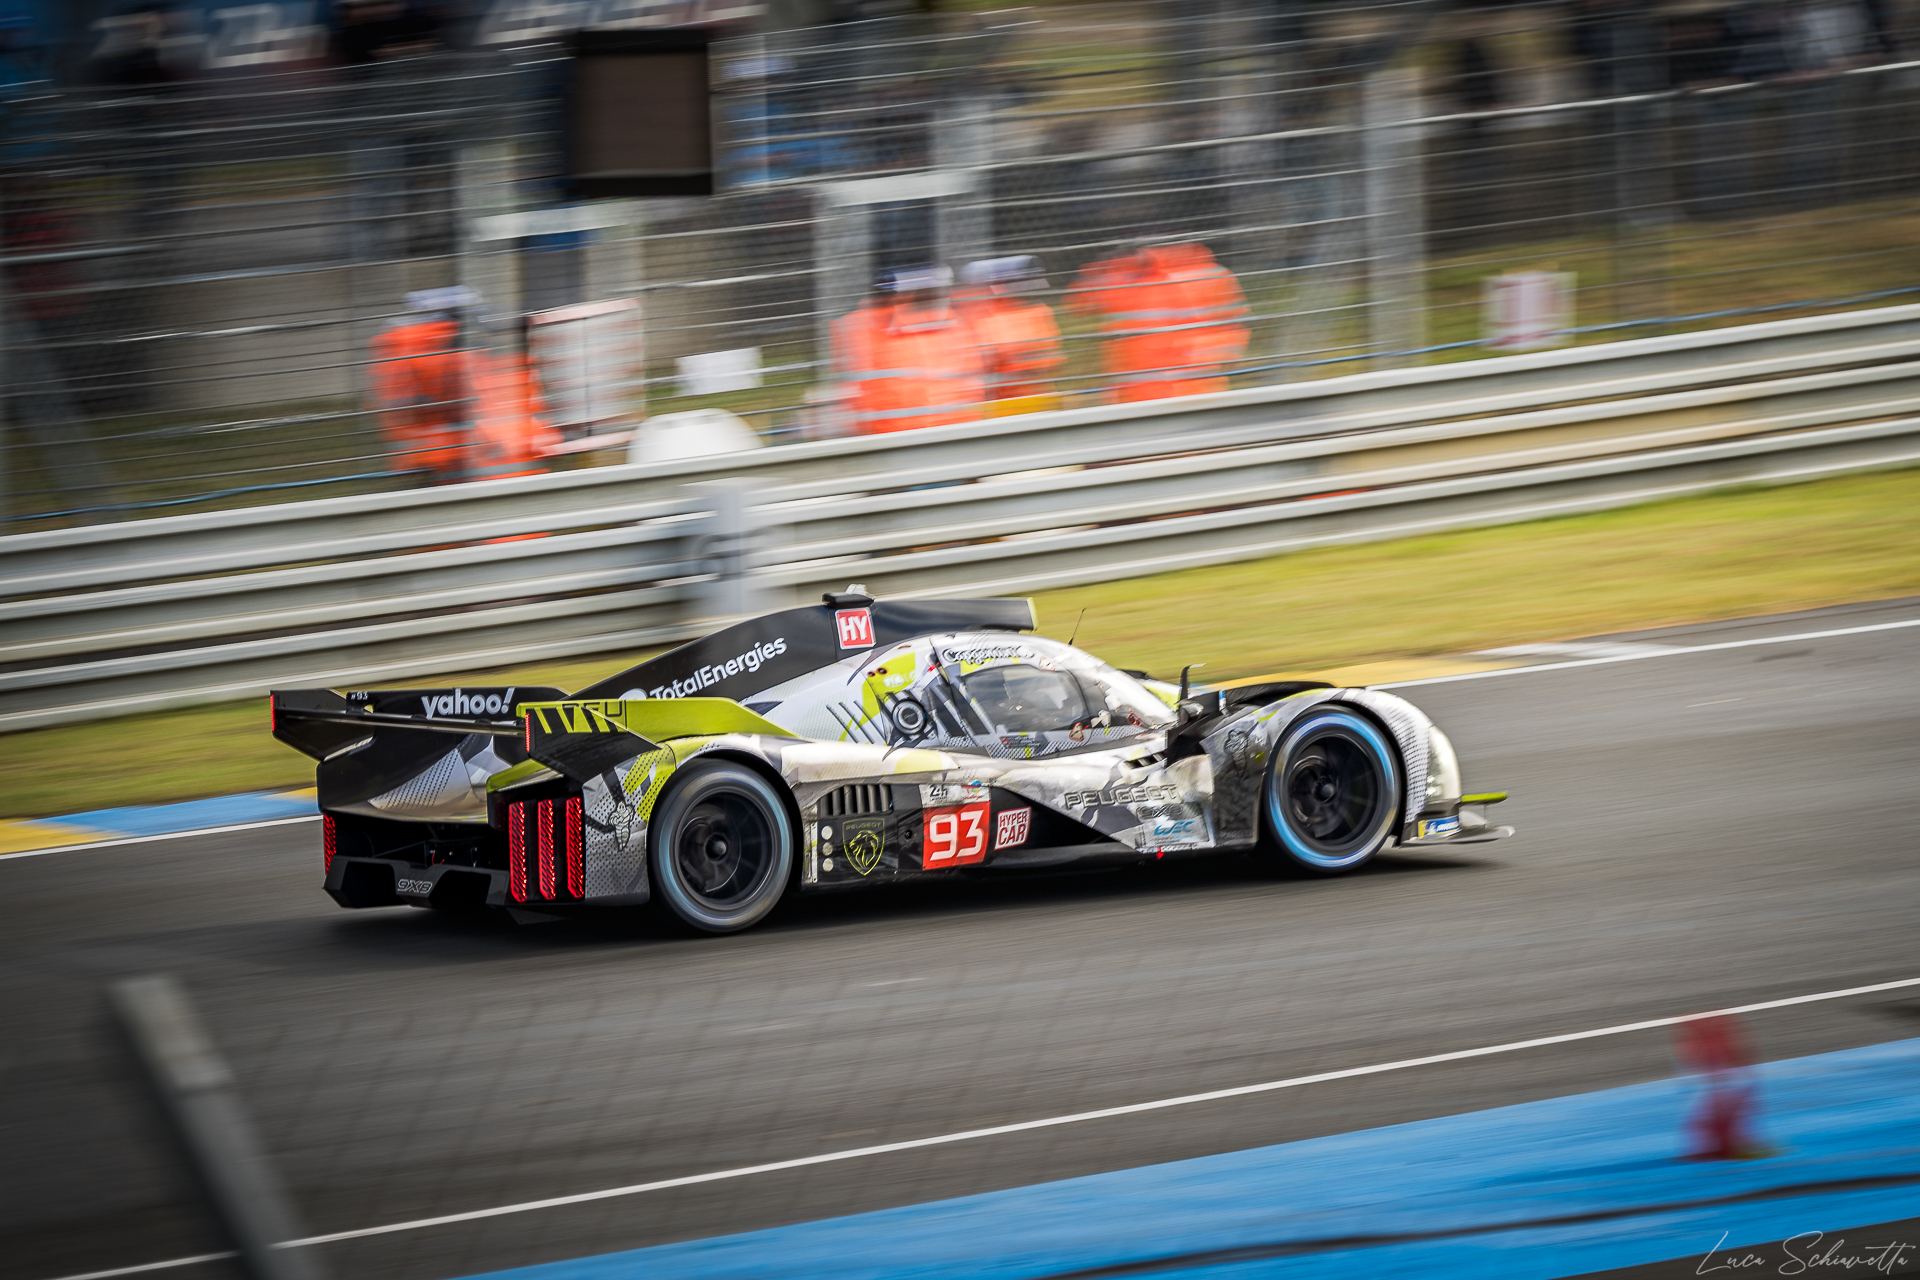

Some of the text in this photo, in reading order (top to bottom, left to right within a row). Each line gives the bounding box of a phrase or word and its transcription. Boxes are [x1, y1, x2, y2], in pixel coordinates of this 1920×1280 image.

[839, 615, 868, 642] HY
[650, 637, 788, 700] TotalEnergies
[421, 687, 515, 719] yahoo!
[999, 808, 1028, 827] HYPER
[929, 810, 984, 862] 93
[998, 824, 1027, 846] CAR
